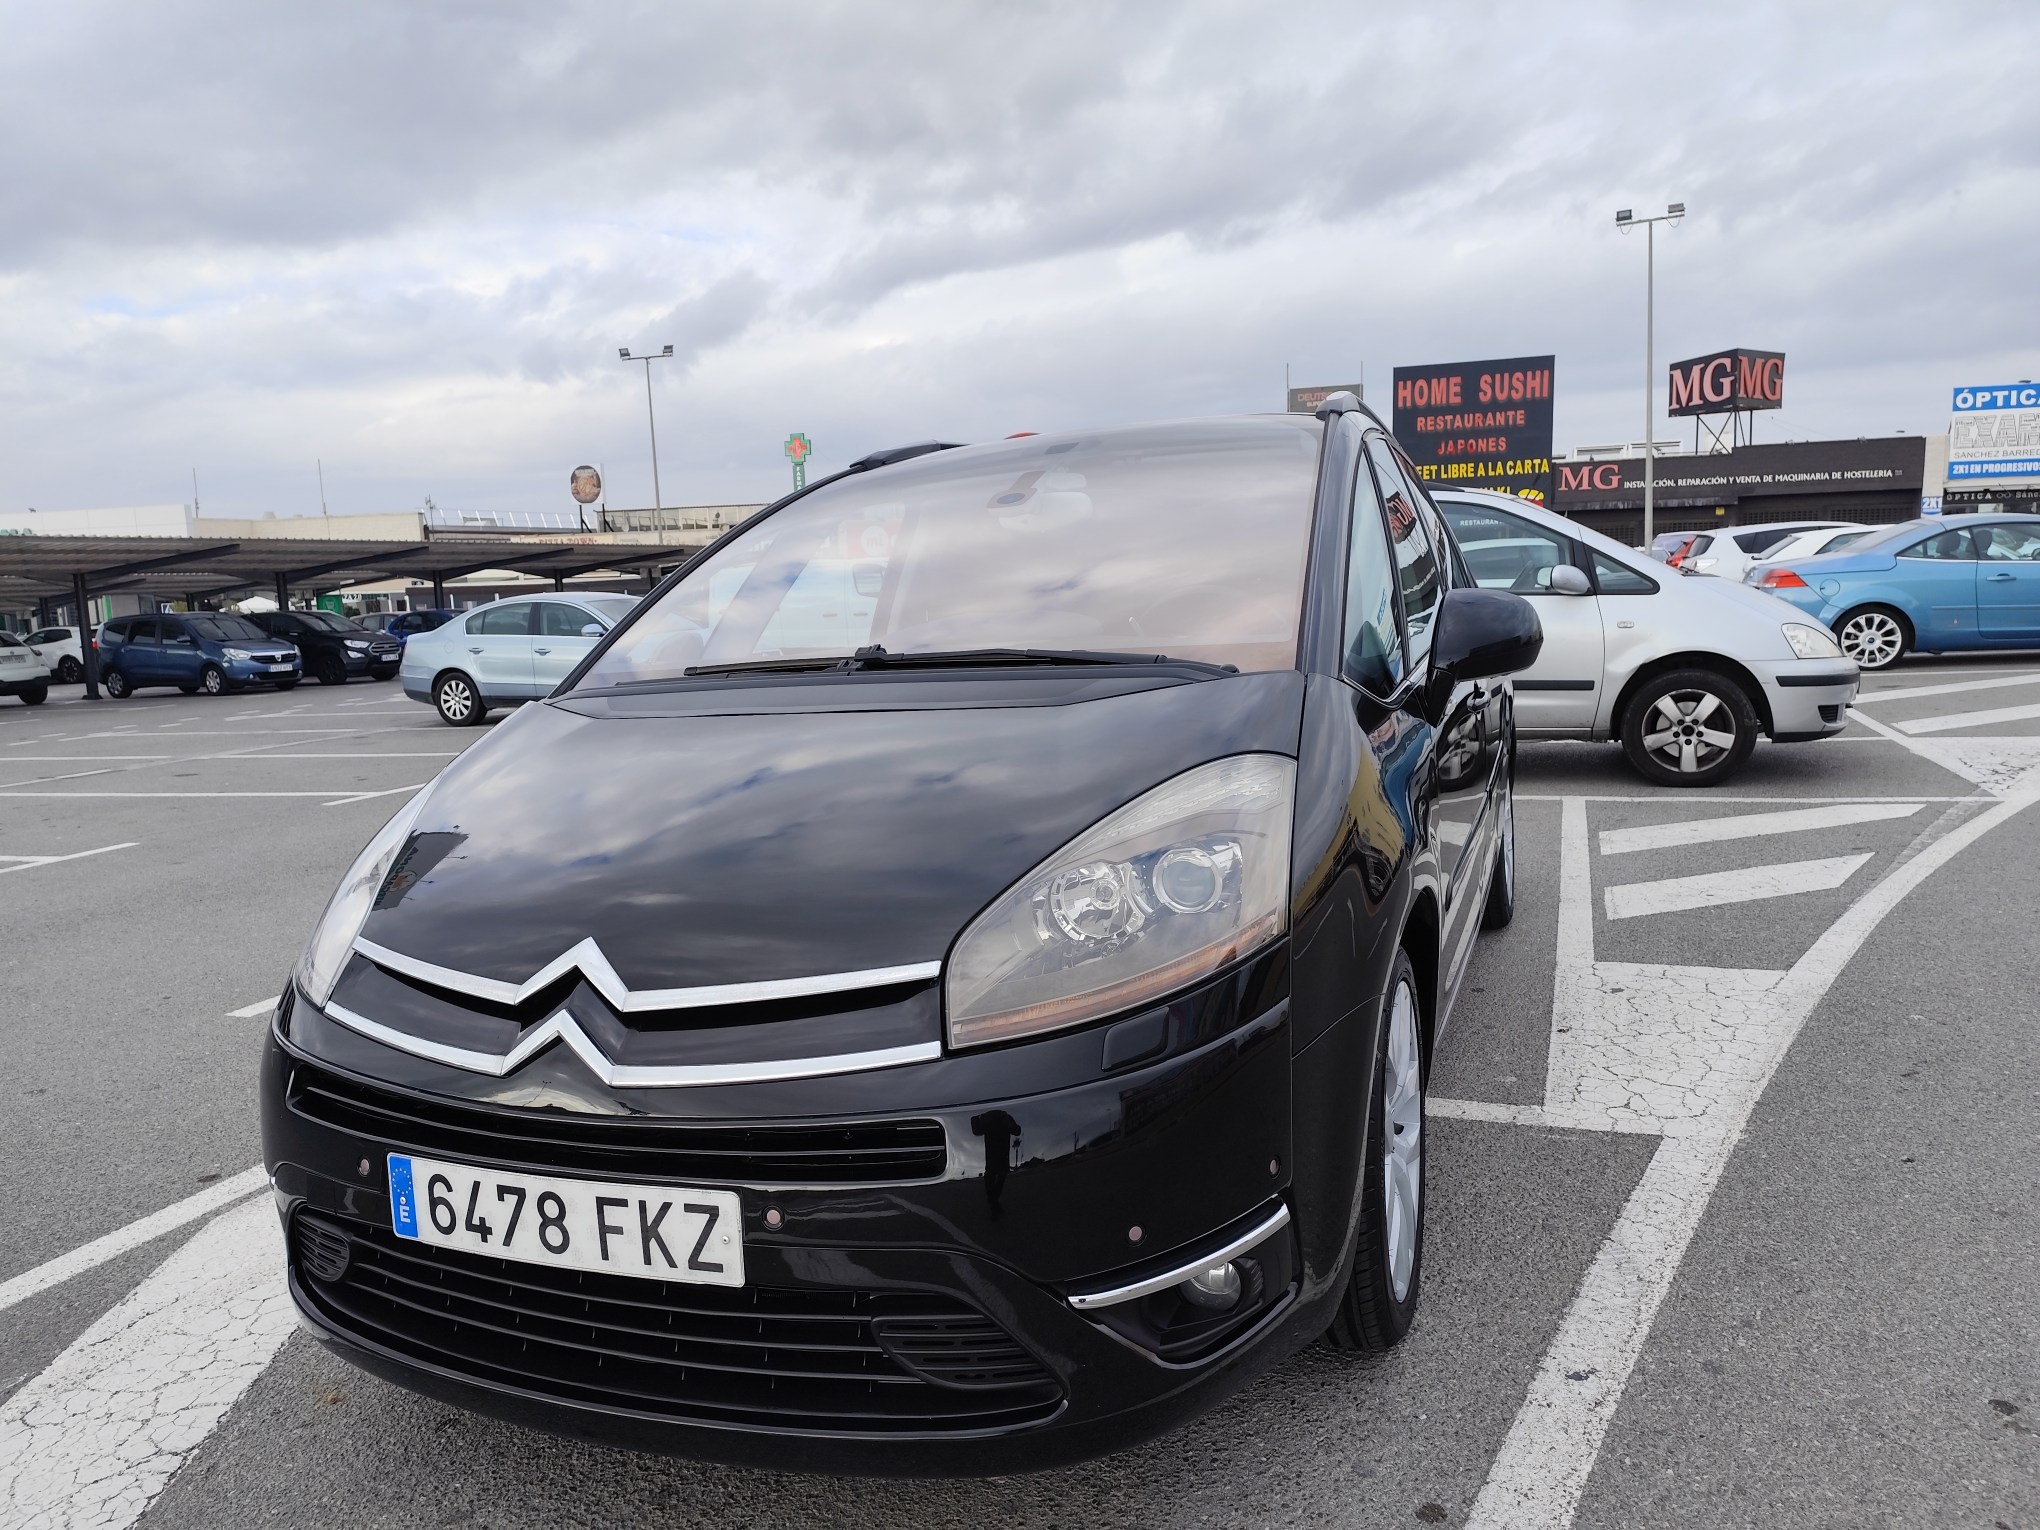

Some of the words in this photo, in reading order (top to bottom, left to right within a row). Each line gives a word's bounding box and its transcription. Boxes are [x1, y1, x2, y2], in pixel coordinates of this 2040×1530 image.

[1398, 376, 1462, 408] HOME
[1478, 369, 1550, 403] SUSHI
[1669, 357, 1735, 409] MG
[1738, 355, 1782, 401] MG
[1955, 388, 2040, 409] ÓPTIC
[1416, 409, 1526, 432] RESTAURANTE
[1437, 436, 1507, 455] JAPONES
[1954, 449, 2000, 459] SÁNCHEZ
[1441, 462, 1475, 479] LIBRE
[1477, 462, 1486, 477] A
[1488, 461, 1504, 476] LA
[1506, 458, 1550, 476] CARTA
[1558, 464, 1622, 491] MG
[1677, 475, 1727, 487] REPARACIÓN
[1729, 476, 1735, 484] Y
[1735, 474, 1761, 484] VENTA
[1763, 474, 1773, 482] DE
[1775, 471, 1829, 483] MAQUINARIA
[1832, 471, 1842, 480] DE
[1844, 469, 1893, 479] HOSTELERIA
[1952, 464, 1969, 474] 2X1
[1970, 464, 1981, 473] EN
[1922, 496, 1941, 509] 2X1
[2015, 491, 2040, 499] Sánc
[399, 1205, 411, 1224] E
[427, 1173, 571, 1255] 6478
[595, 1196, 725, 1274] FKZ
